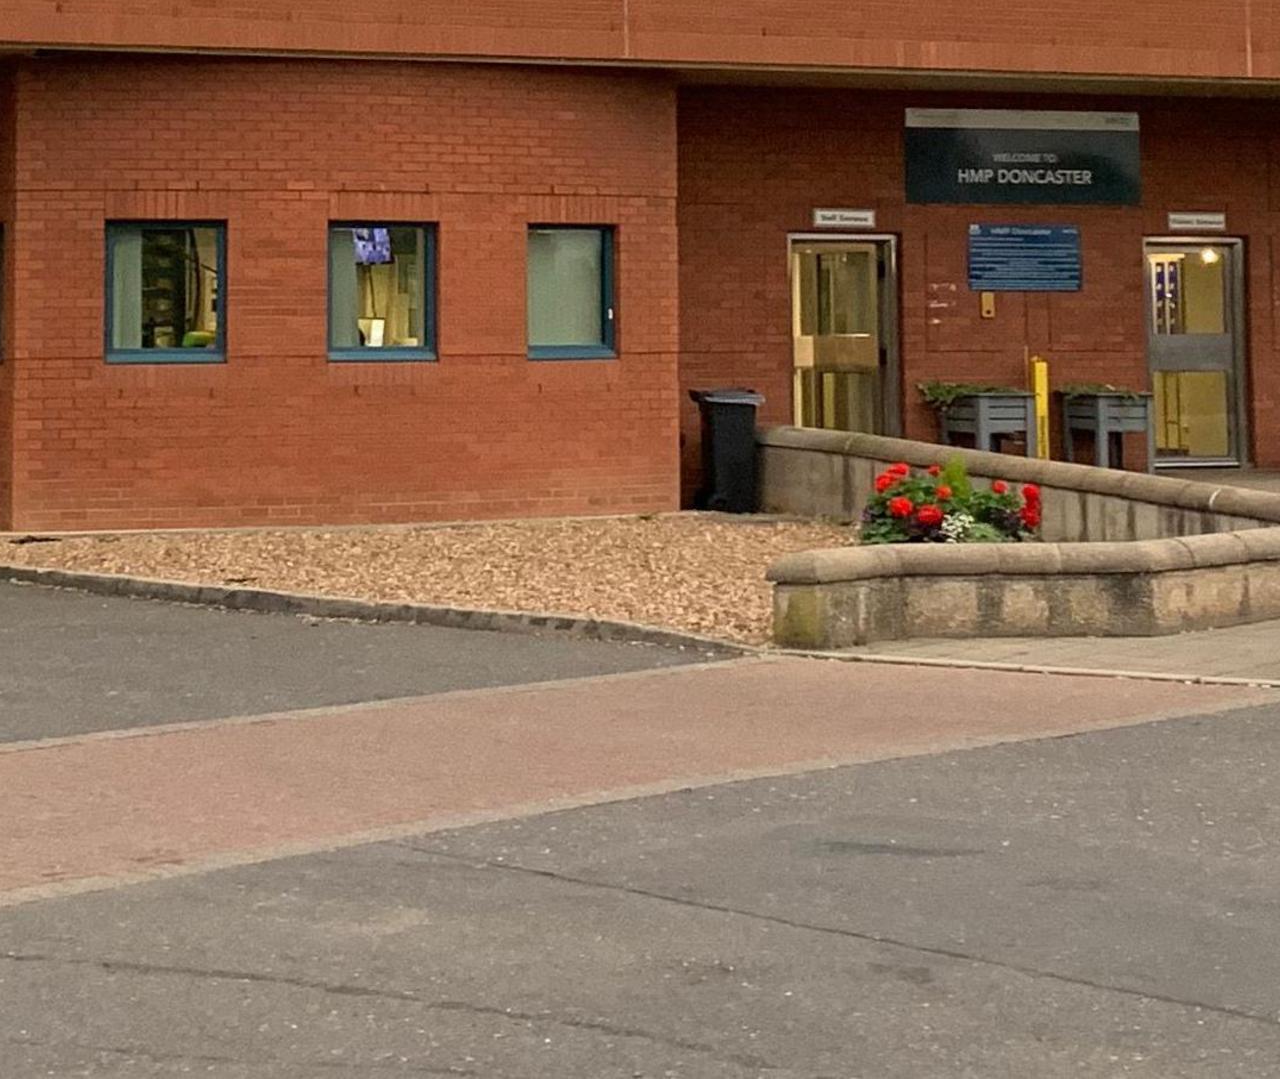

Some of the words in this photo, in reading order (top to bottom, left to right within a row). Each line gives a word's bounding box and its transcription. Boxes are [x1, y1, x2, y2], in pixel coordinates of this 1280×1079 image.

[992, 153, 1040, 163] WELCOME
[1043, 154, 1057, 164] TO
[958, 168, 994, 184] HMP
[998, 169, 1092, 185] DONCASTER
